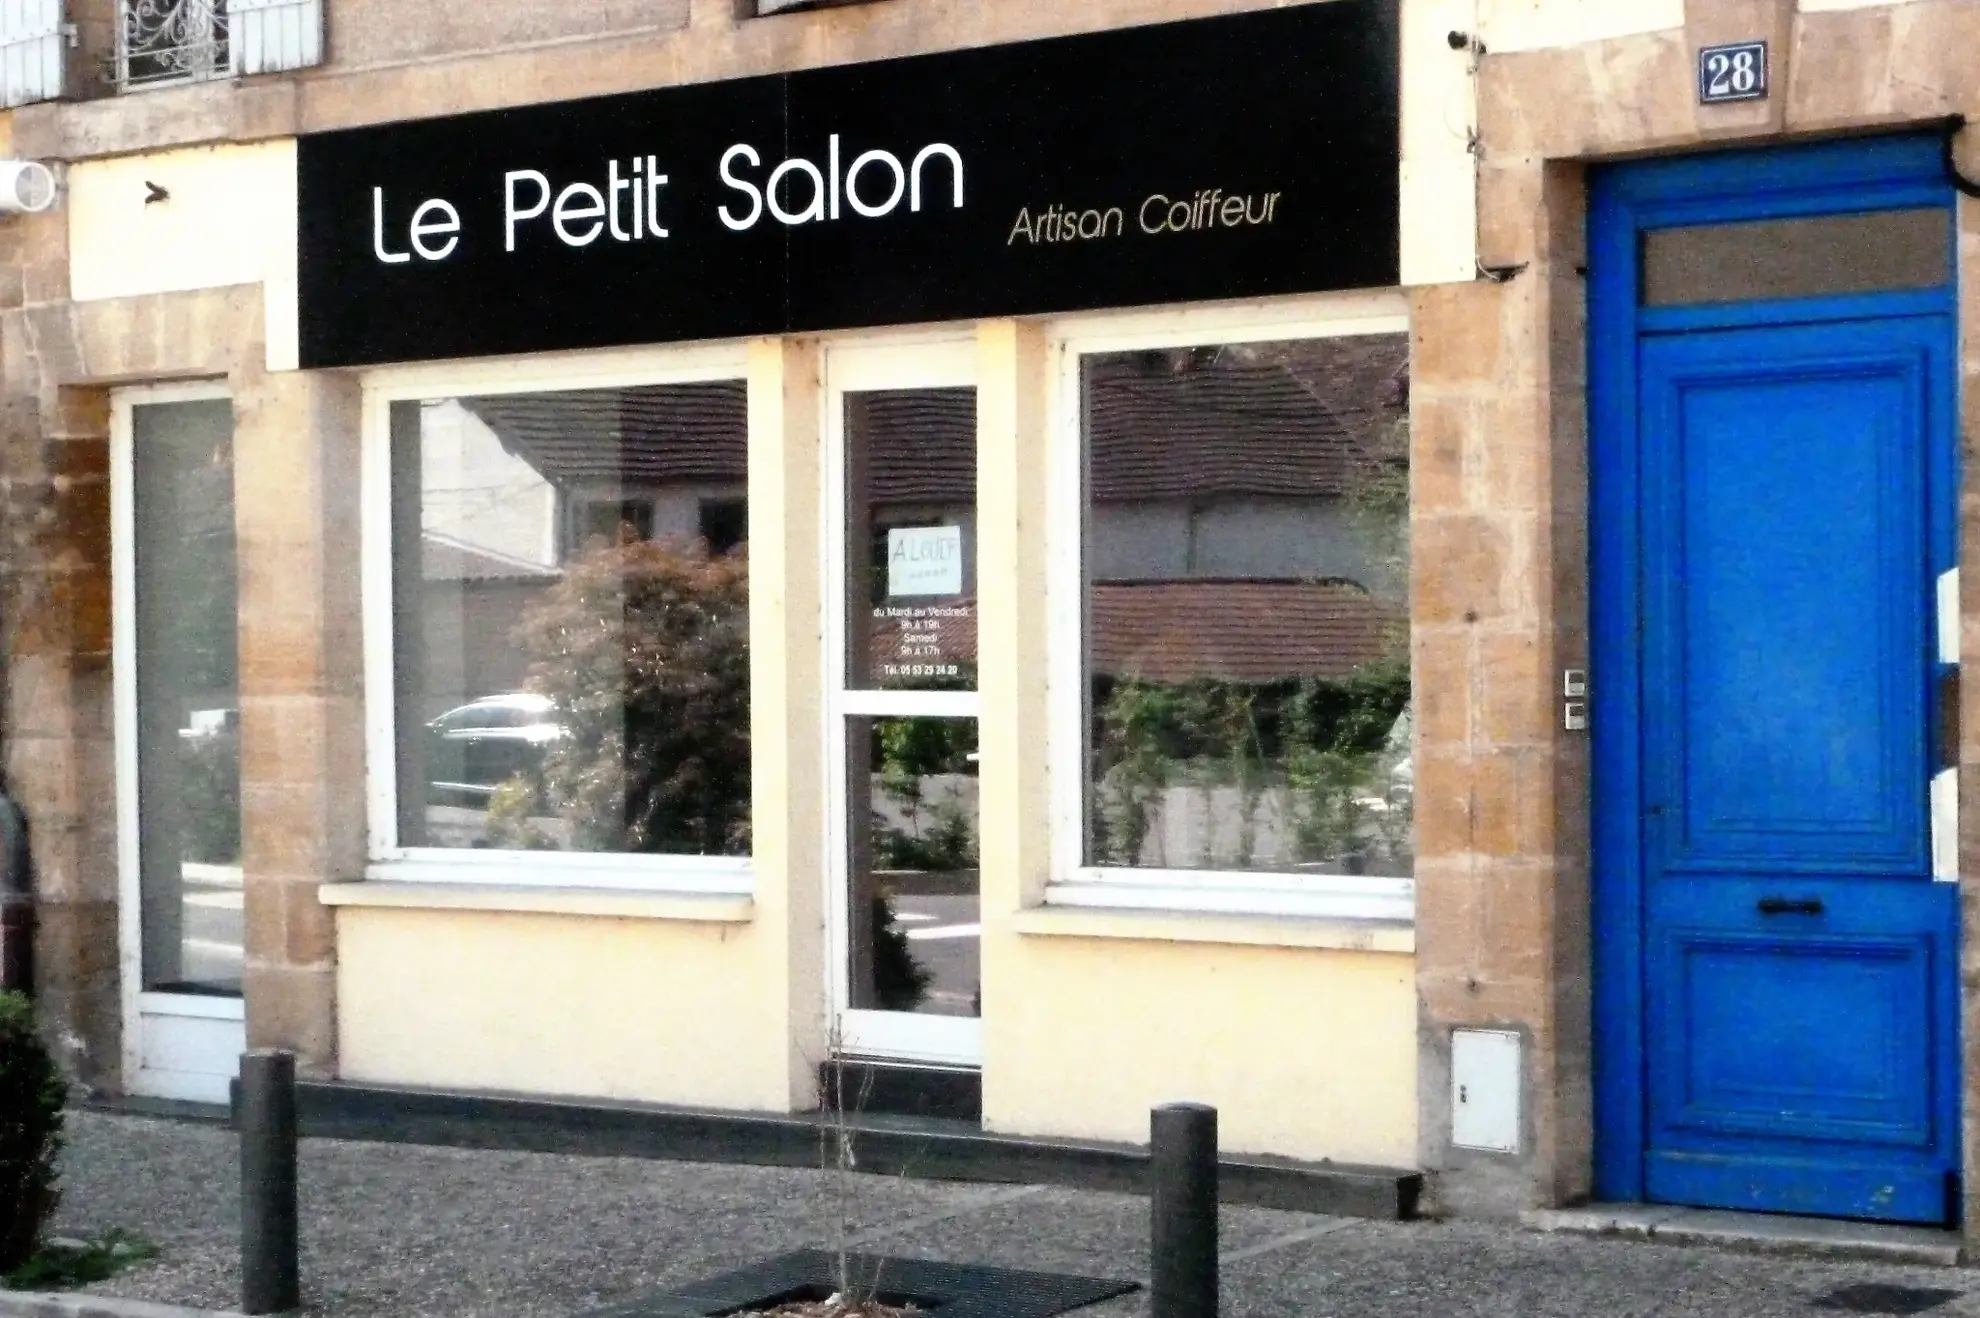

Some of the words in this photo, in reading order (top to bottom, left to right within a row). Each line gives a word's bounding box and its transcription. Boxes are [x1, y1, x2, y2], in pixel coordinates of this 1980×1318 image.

[1708, 51, 1755, 95] 28
[373, 186, 461, 264] Le
[505, 154, 669, 252] Petit
[717, 133, 964, 231] Salon
[1007, 204, 1124, 246] Artisan
[1139, 188, 1282, 235] Coiffeur
[873, 607, 885, 617] du
[887, 606, 912, 617] Mardi
[914, 608, 926, 617] au
[927, 606, 968, 617] Vendredi
[901, 620, 912, 629] 9h
[924, 619, 940, 629] 19h
[903, 632, 938, 643] Samedi
[901, 646, 912, 656] 9h
[924, 645, 941, 656] 17h
[900, 665, 911, 675] 05
[912, 665, 922, 675] 53
